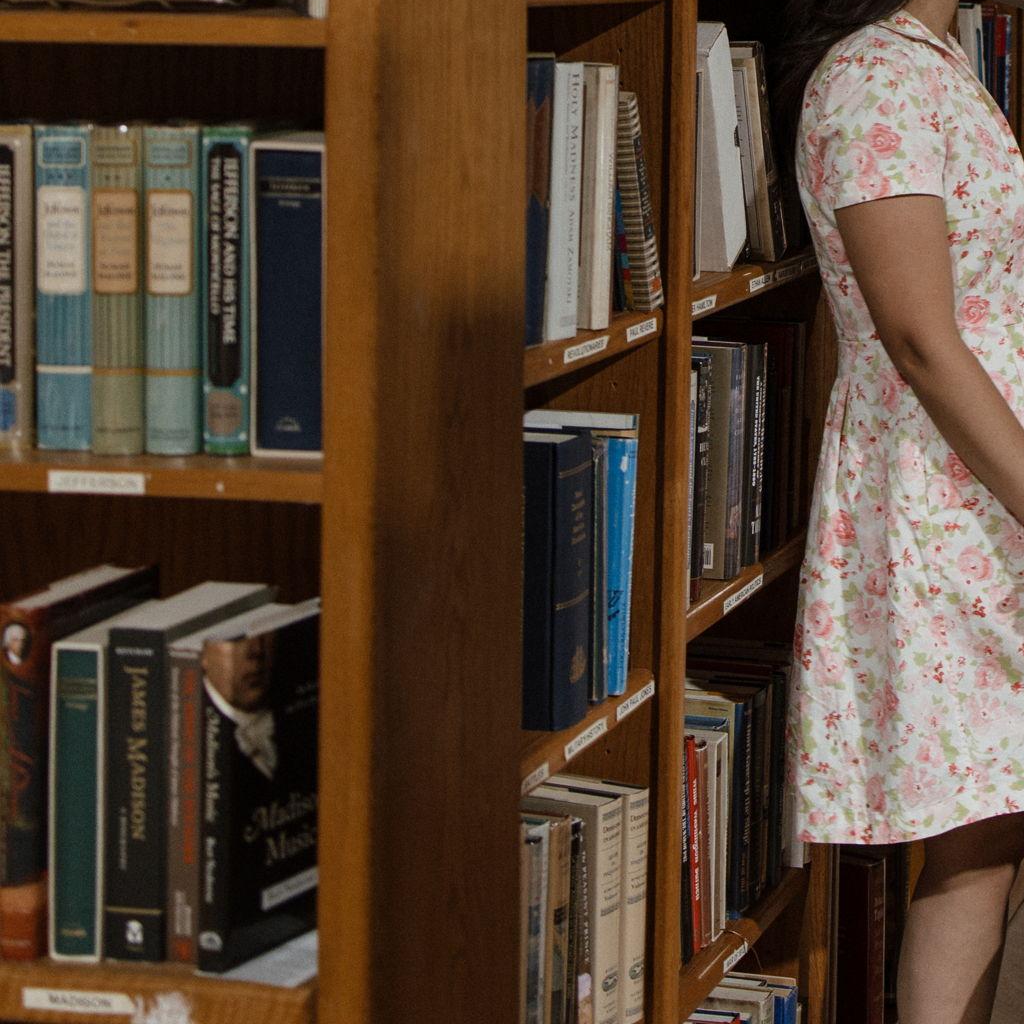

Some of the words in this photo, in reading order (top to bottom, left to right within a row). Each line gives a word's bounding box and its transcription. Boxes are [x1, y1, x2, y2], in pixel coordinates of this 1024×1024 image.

[571, 72, 580, 116] HOLY
[569, 125, 579, 203] MADNESS
[223, 157, 240, 240] JEFFERSON
[568, 209, 576, 243] ADAM
[223, 241, 238, 276] AND
[566, 247, 574, 305] ZAMOYSKI
[223, 278, 238, 303] HIS
[222, 305, 238, 345] TIME
[123, 665, 150, 734] JAMES
[126, 737, 151, 842] MADISON
